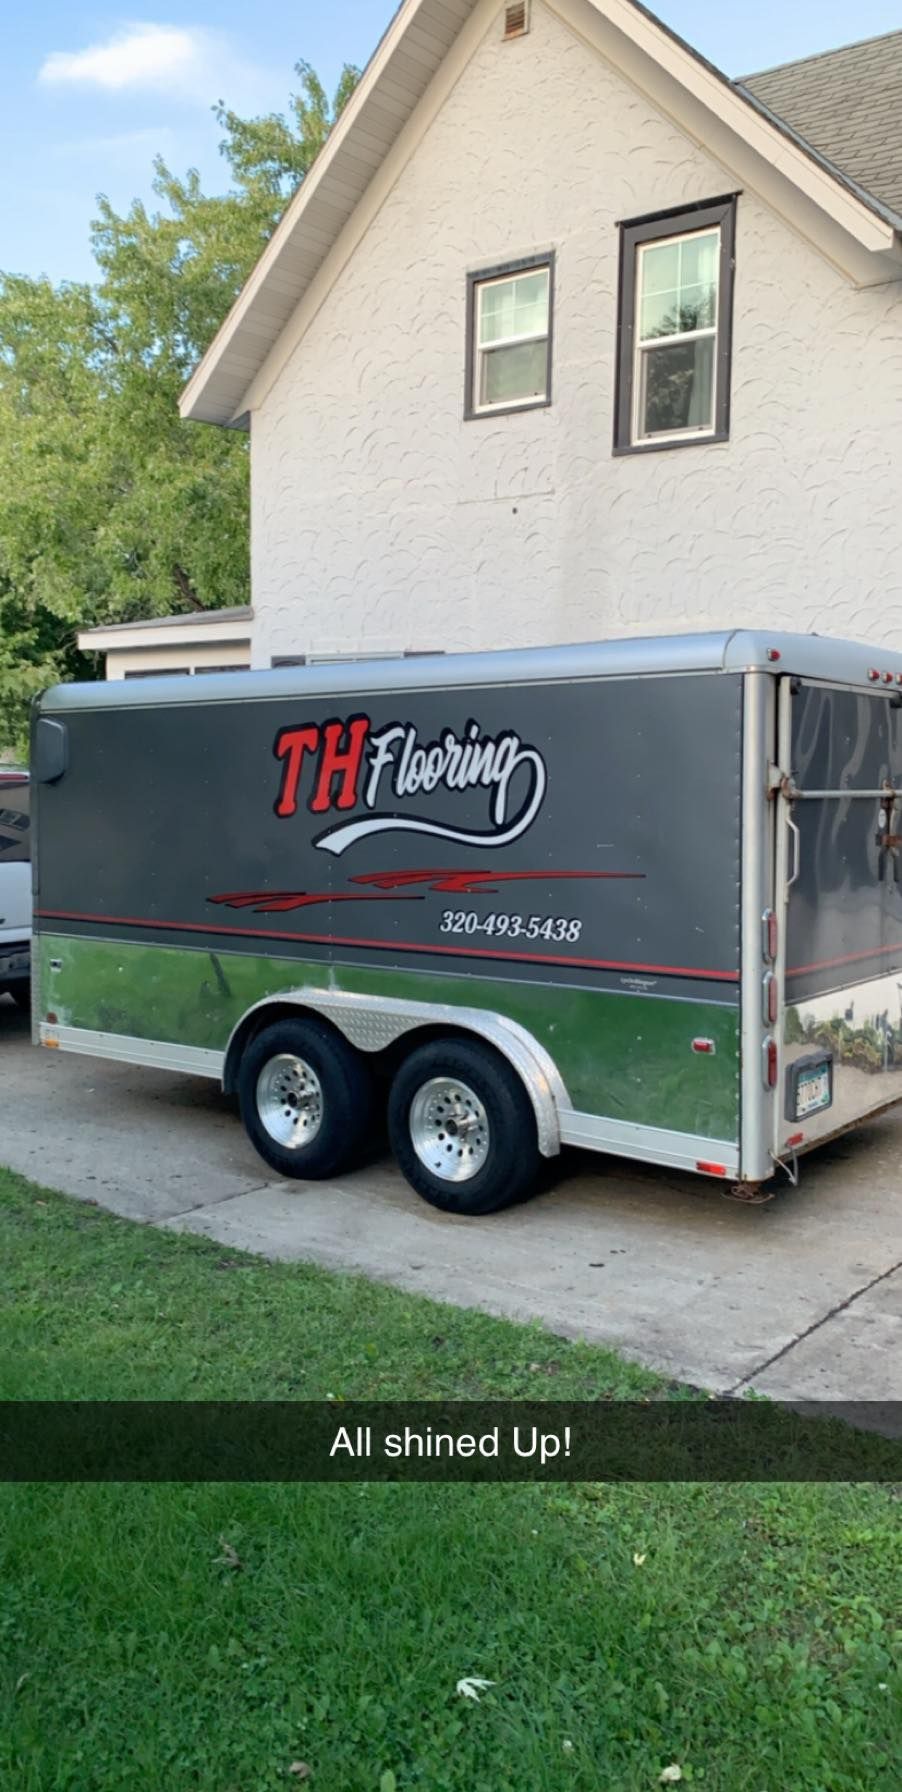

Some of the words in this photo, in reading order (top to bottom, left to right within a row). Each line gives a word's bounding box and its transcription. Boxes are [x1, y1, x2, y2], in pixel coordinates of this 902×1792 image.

[275, 714, 369, 817] TH
[364, 719, 547, 838] Flooring
[440, 910, 583, 942] 320-493-5438
